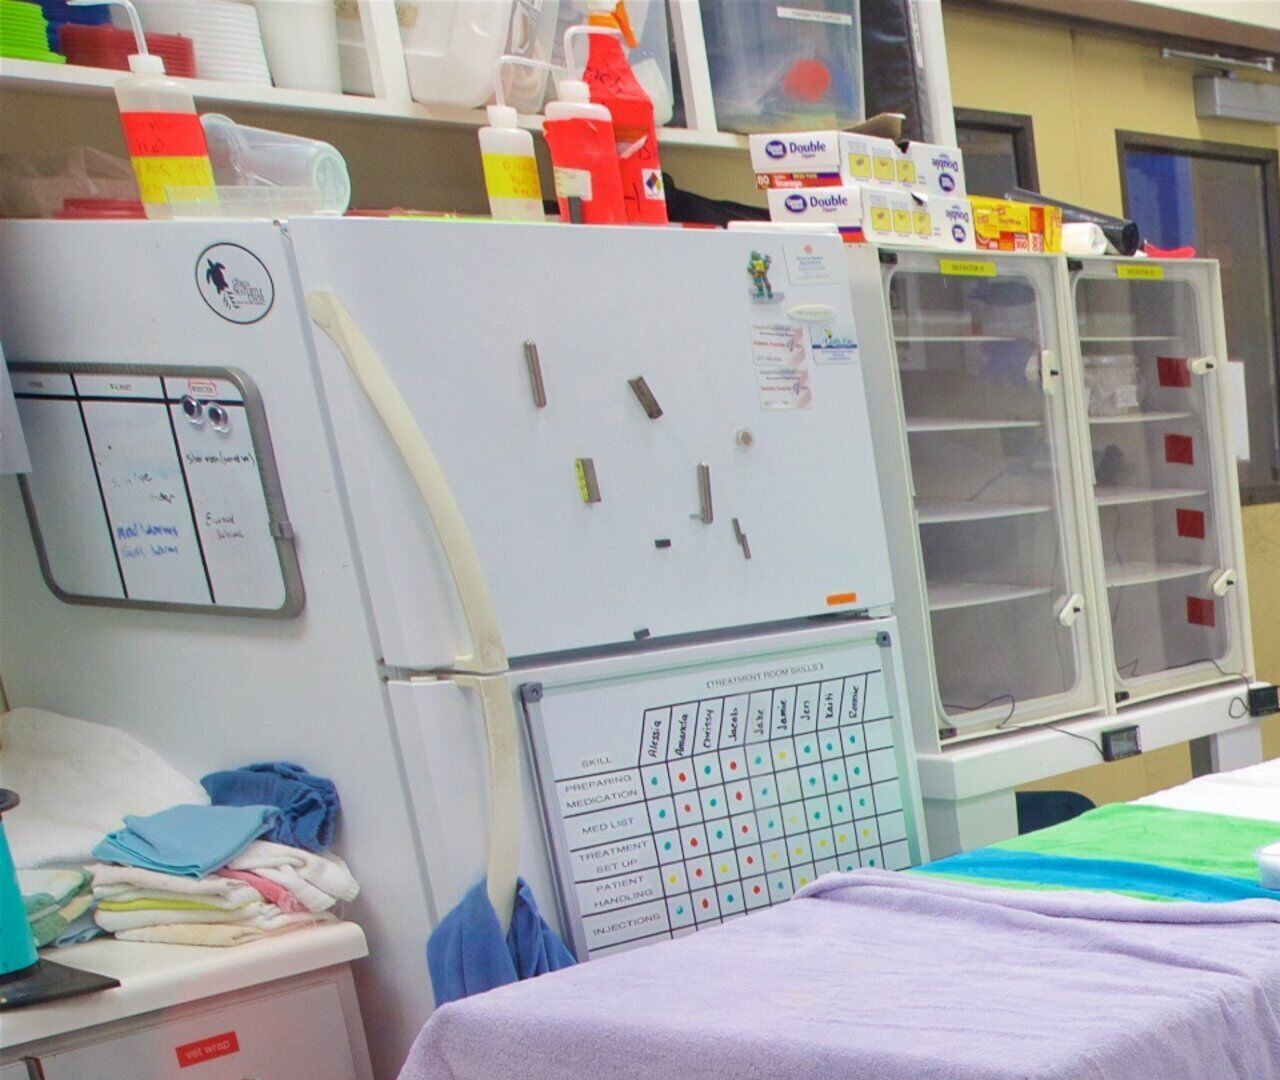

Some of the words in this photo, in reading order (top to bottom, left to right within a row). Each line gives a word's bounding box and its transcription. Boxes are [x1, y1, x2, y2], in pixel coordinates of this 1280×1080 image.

[789, 140, 826, 155] Double
[932, 158, 959, 172] Double
[809, 194, 848, 208] Double
[945, 209, 970, 223] Double
[763, 668, 788, 681] ROOM
[777, 698, 788, 732] Jamie
[800, 699, 811, 722] Jen
[702, 708, 715, 749] Chrissy
[727, 706, 739, 742] Jacob
[753, 708, 766, 735] Jake
[648, 719, 662, 758] Alessia
[676, 712, 689, 756] Amanda
[581, 756, 612, 769] SKILL
[565, 774, 632, 793] PREPARING
[566, 788, 639, 809] MEDICATION
[582, 821, 608, 835] MED
[610, 817, 635, 830] LIST
[578, 839, 649, 862] TREATMENT
[596, 862, 619, 874] SET
[622, 858, 639, 869] UP
[596, 875, 644, 893] PATIENT
[594, 888, 654, 909] HANDLING
[592, 911, 662, 937] INJECTIONS
[185, 1047, 203, 1060] vet
[203, 1040, 231, 1054] wrap
